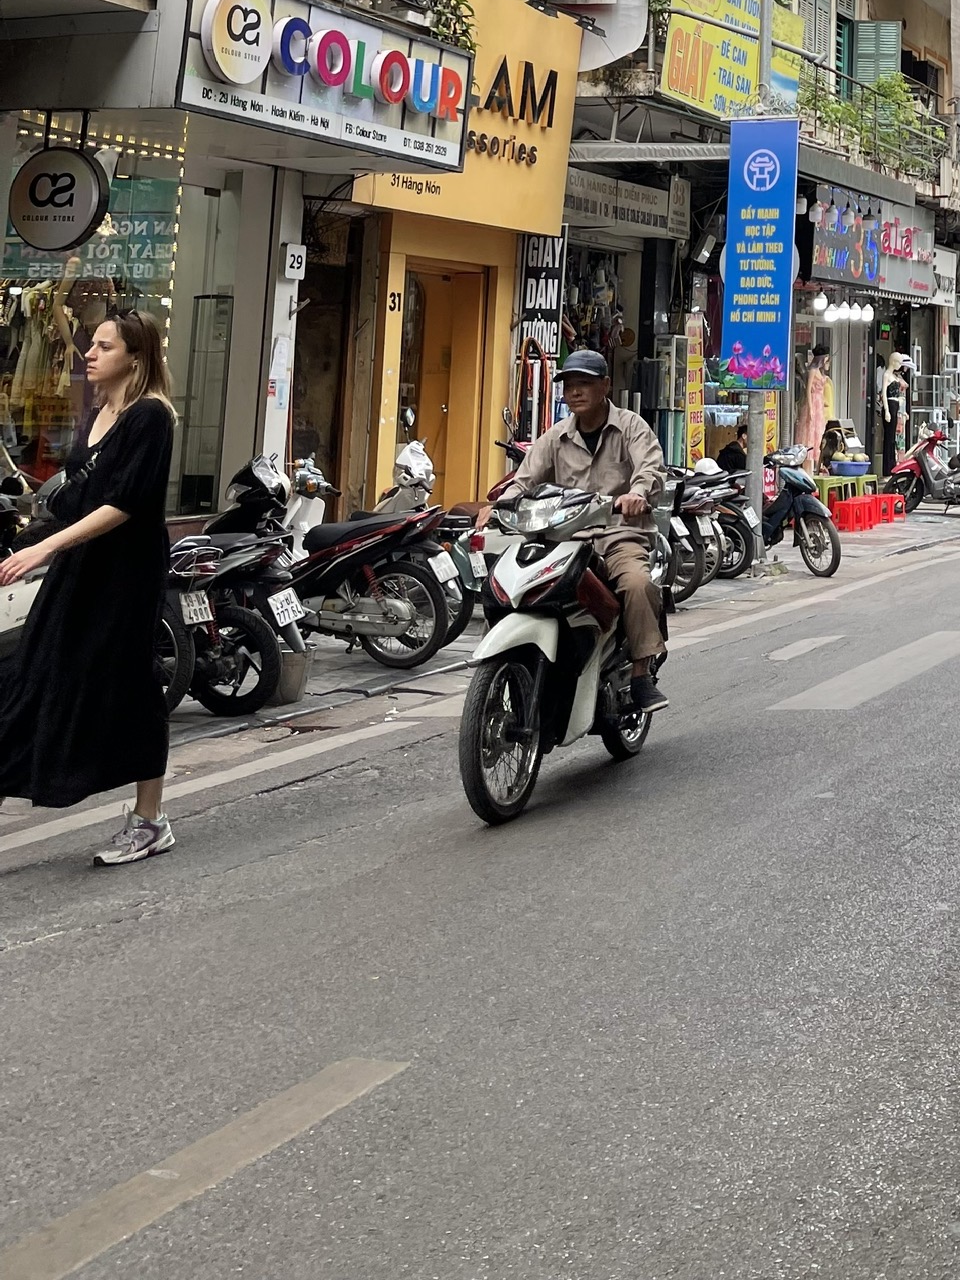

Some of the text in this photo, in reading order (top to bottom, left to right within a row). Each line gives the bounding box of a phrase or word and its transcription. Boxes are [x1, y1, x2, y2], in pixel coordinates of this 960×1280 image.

[220, 46, 262, 63] COLOUR STORE
[732, 46, 748, 67] CAN
[274, 16, 462, 122] COLOUR
[219, 91, 229, 103] 29
[230, 95, 248, 111] Hàng
[250, 99, 264, 113] Nón
[355, 125, 372, 139] Colour
[372, 130, 387, 142] Store
[390, 173, 441, 195] 31 Hàng Nón
[569, 173, 585, 190] CỬA
[587, 178, 607, 194] HÀNG
[673, 182, 686, 207] 33
[745, 224, 776, 239] HỌC TẬP
[736, 240, 746, 253] VÀ
[765, 242, 783, 253] THEO
[289, 254, 303, 270] 29
[525, 272, 558, 309] DÁN
[733, 291, 780, 305] PHONG CÁCH
[388, 292, 401, 312] 31
[756, 311, 776, 323] MINH
[689, 389, 703, 405] GET 1
[690, 411, 703, 424] FREE
